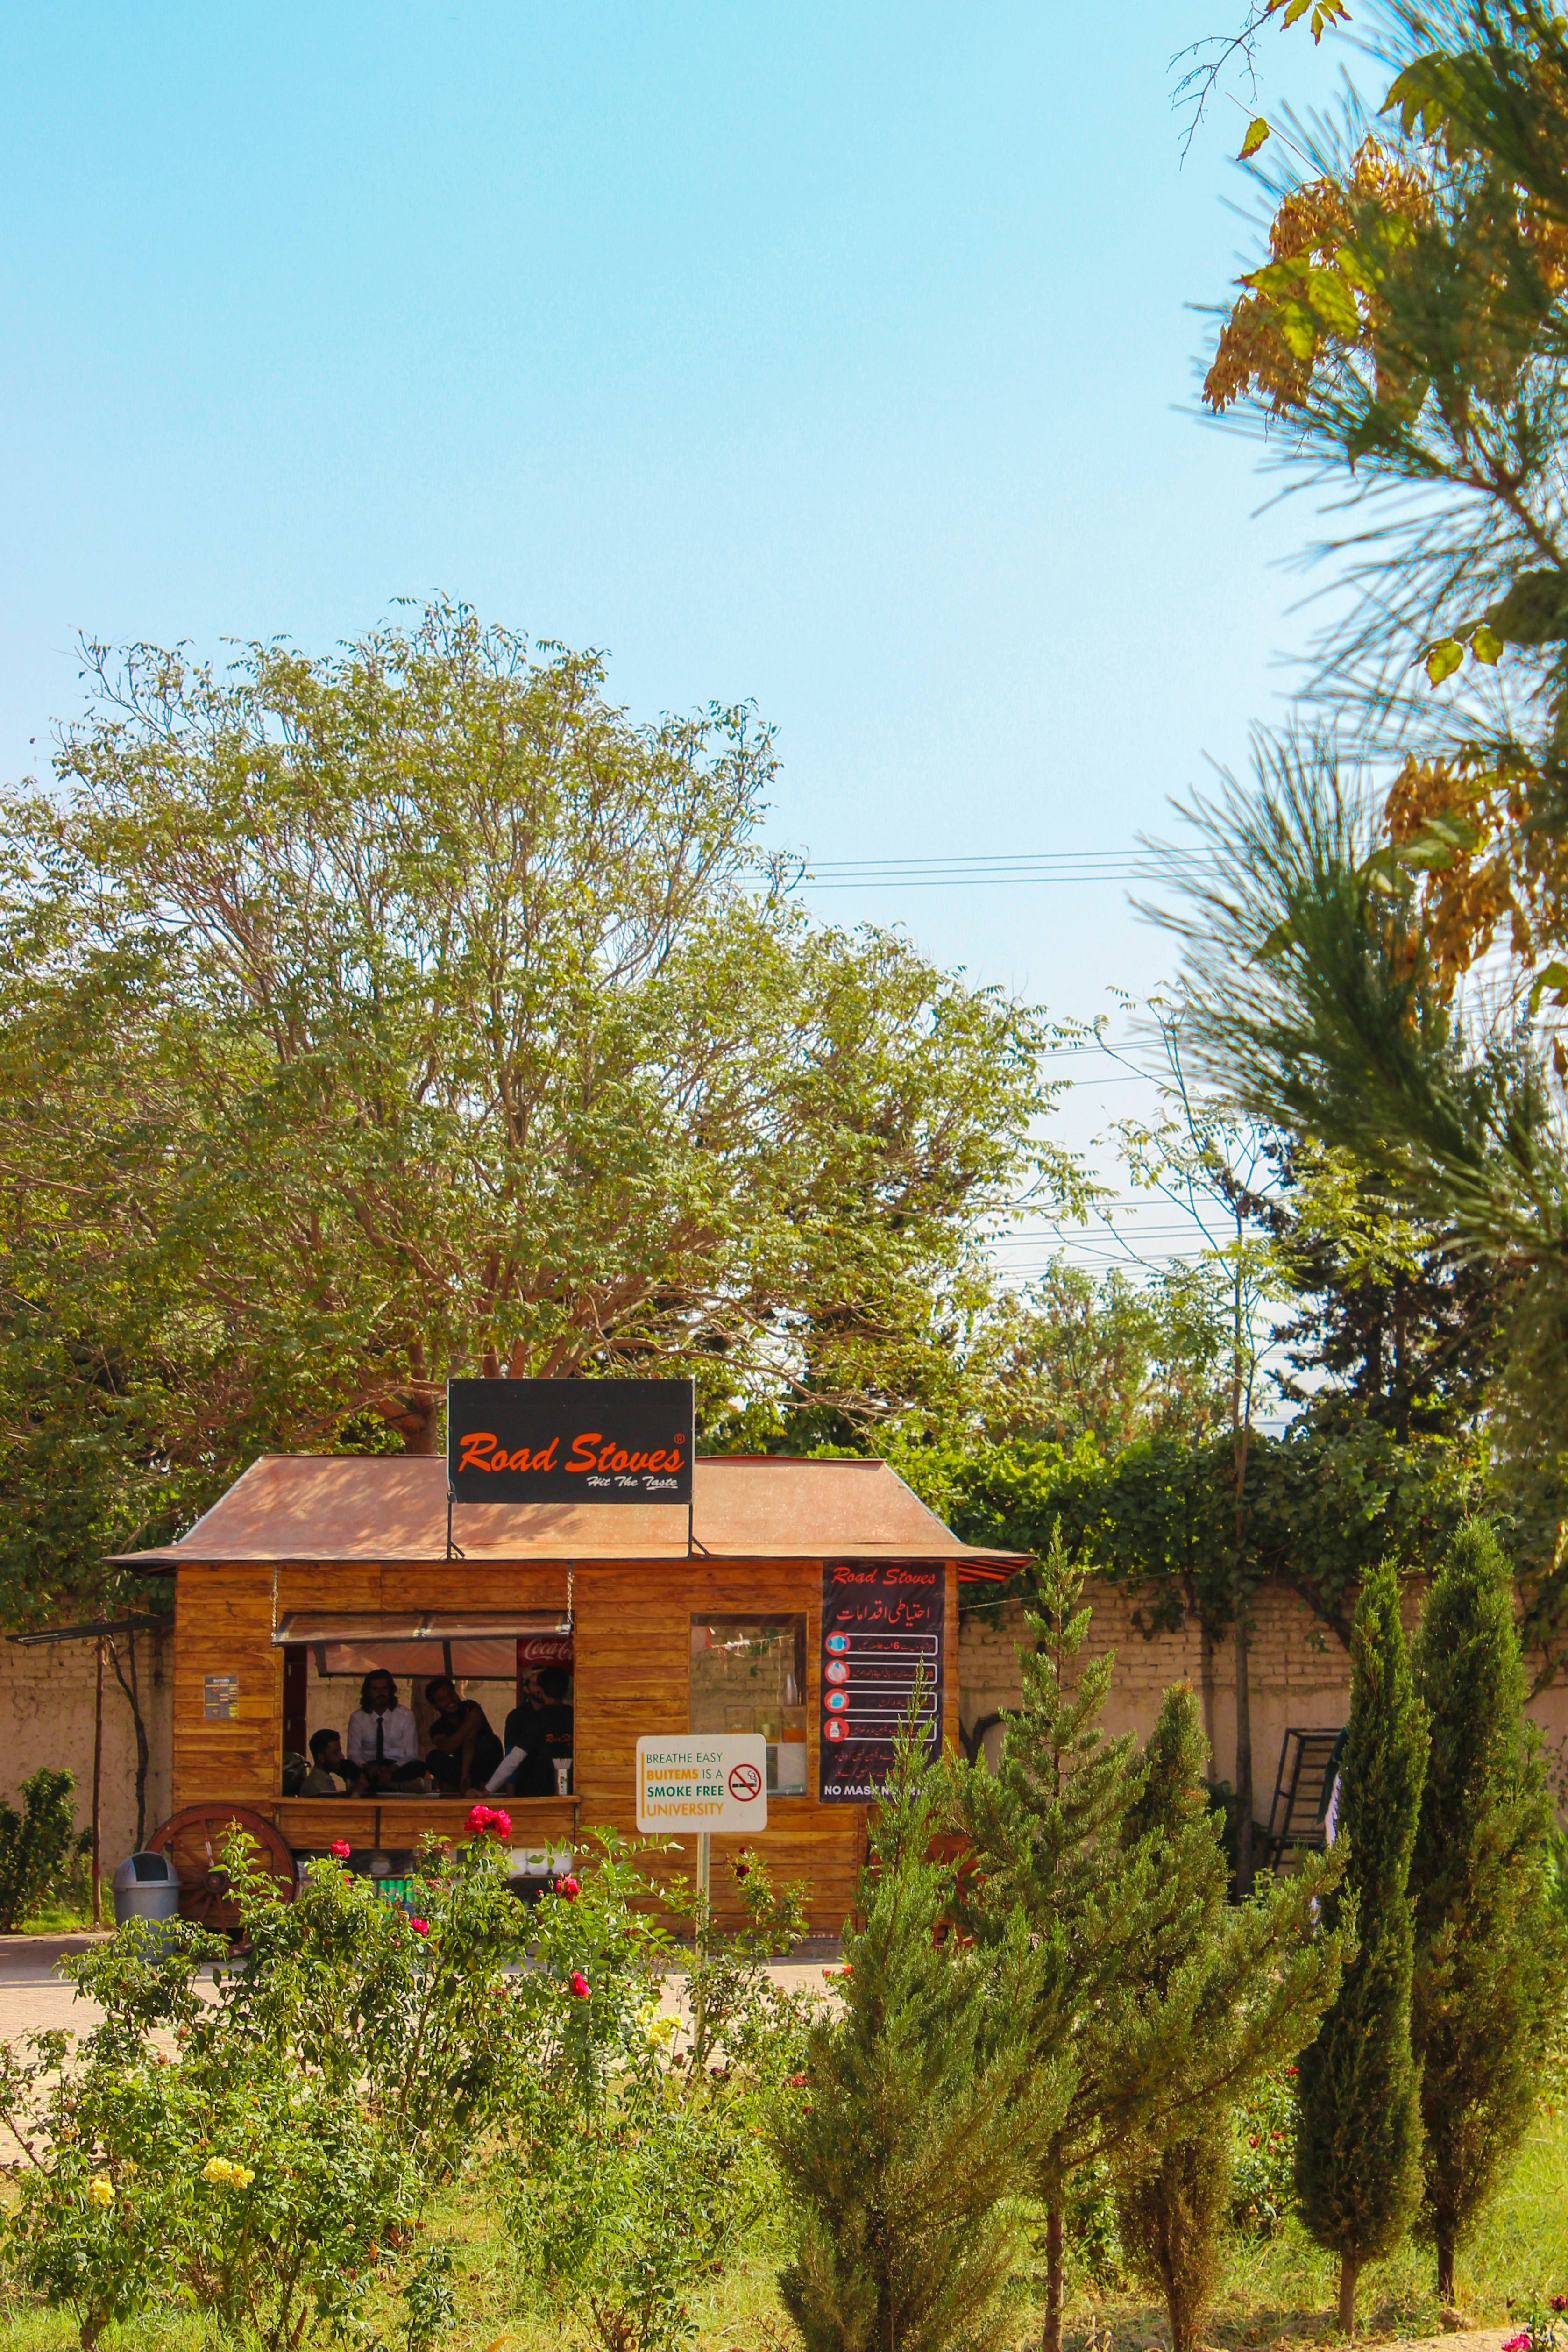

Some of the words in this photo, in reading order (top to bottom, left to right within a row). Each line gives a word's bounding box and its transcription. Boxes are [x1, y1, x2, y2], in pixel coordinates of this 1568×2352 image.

[458, 1432, 560, 1472] Road
[564, 1433, 685, 1472] Stoves
[586, 1476, 610, 1487] Hit
[614, 1476, 638, 1487] The
[642, 1476, 678, 1490] Taste
[832, 1567, 878, 1584] Road
[882, 1568, 936, 1585] Stoves
[646, 1753, 692, 1763] BREATHE
[696, 1752, 723, 1762] EASY
[647, 1769, 698, 1780] BUITEMS
[702, 1769, 711, 1779] IS
[716, 1769, 723, 1778] A
[647, 1786, 691, 1797] SMOKE
[696, 1785, 724, 1796] FREE
[824, 1786, 841, 1795] NO
[647, 1802, 724, 1816] UNIVERSITY
